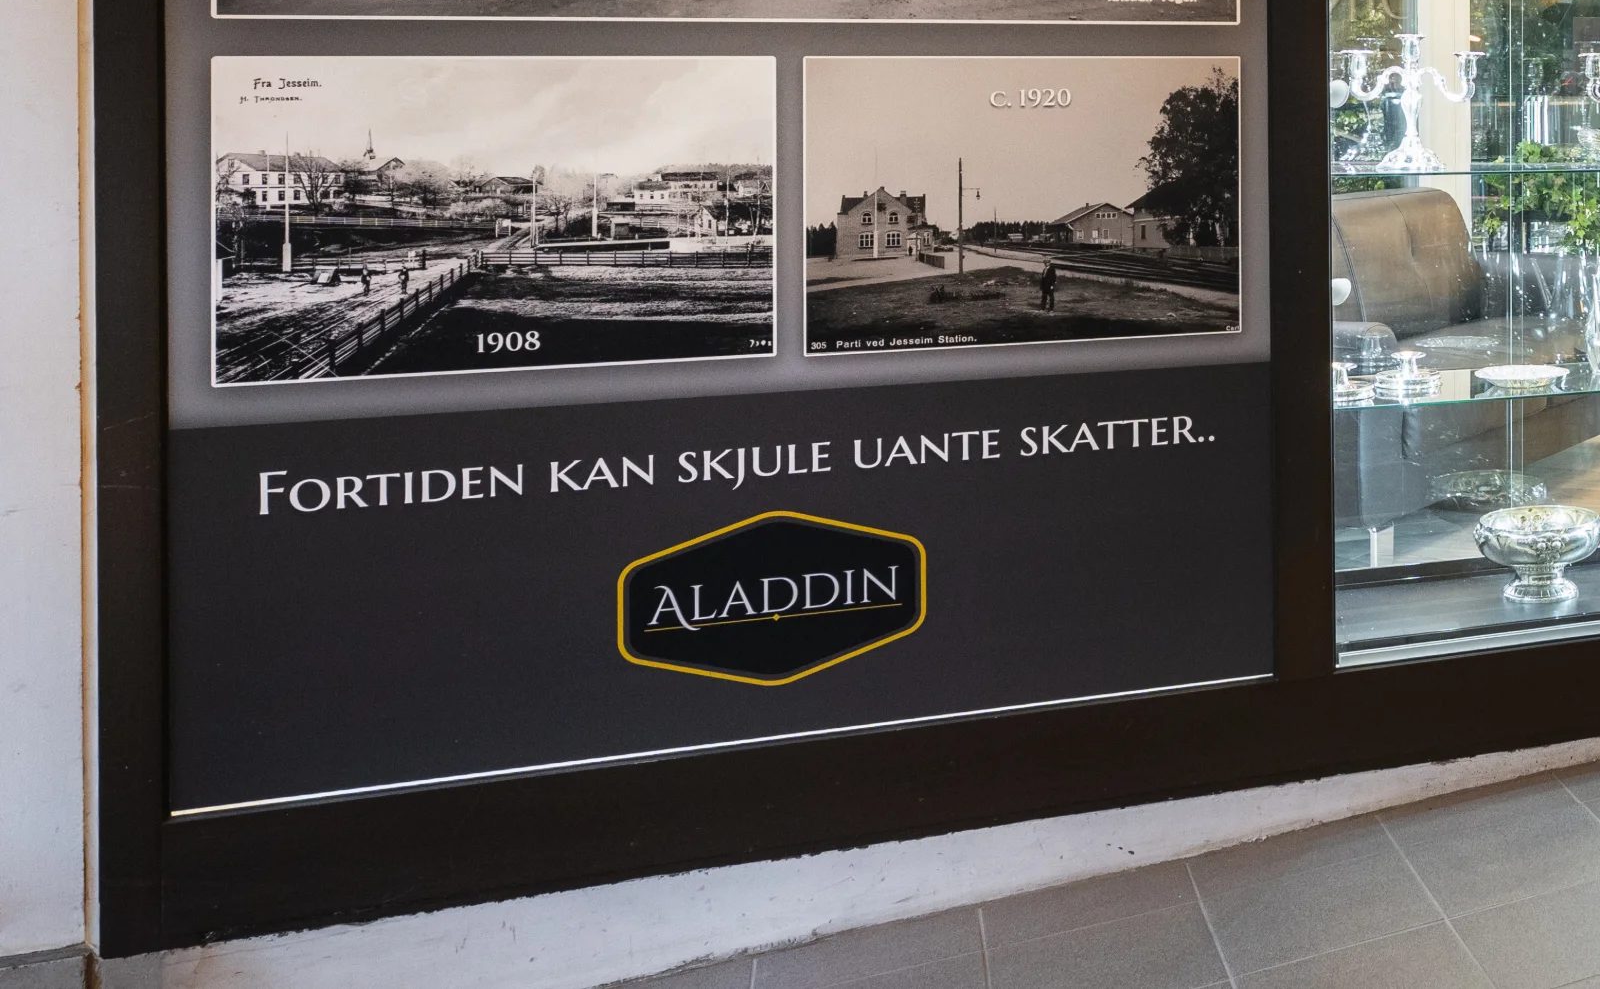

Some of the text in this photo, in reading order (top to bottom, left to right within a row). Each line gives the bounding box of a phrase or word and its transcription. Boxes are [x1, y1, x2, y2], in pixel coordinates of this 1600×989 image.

[253, 77, 322, 90] Fra Jesseim.
[1019, 88, 1072, 108] 1920
[477, 331, 541, 354] 1908
[810, 334, 978, 350] 305 Parti ved Jesseim Station.
[259, 463, 523, 515] FORTIDEN
[550, 454, 654, 493] KAN
[678, 441, 832, 491] SKJULE
[647, 565, 900, 631] ALADDIN
